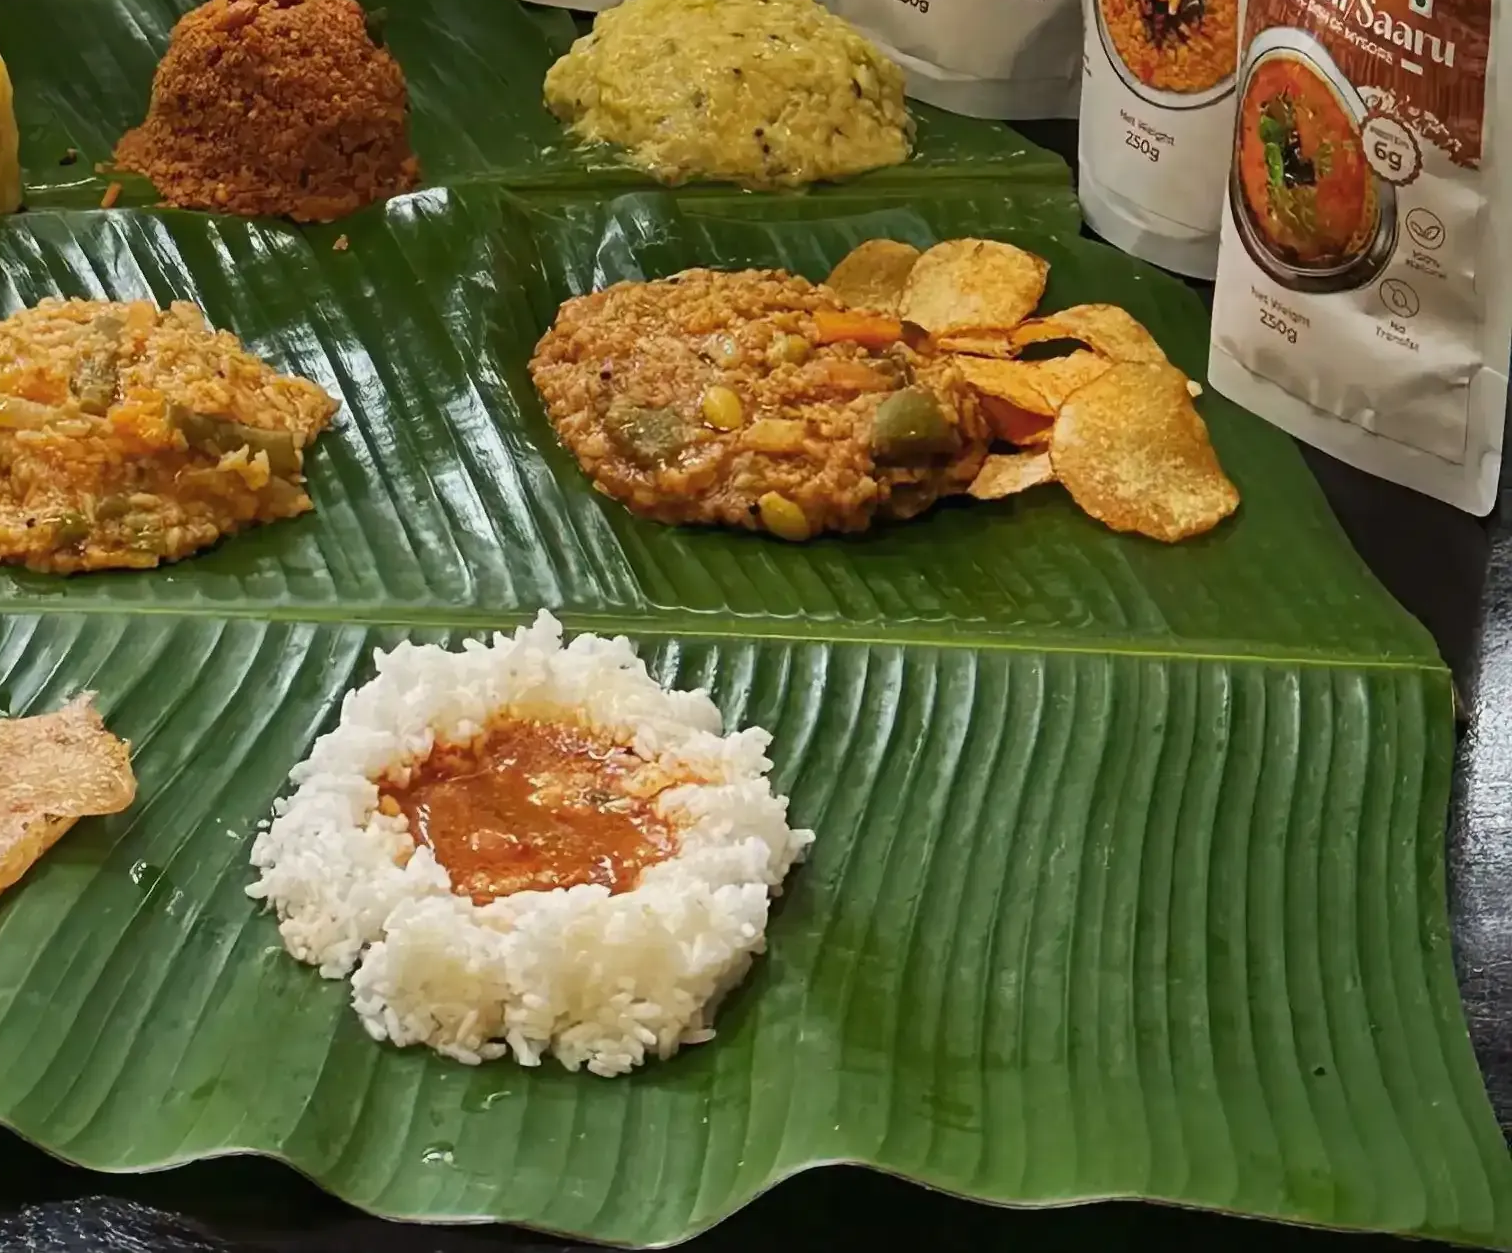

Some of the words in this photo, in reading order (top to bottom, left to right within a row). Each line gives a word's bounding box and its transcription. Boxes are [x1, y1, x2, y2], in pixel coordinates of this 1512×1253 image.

[1125, 131, 1160, 163] 250g
[1374, 141, 1402, 171] 6g
[1260, 309, 1298, 344] 250g
